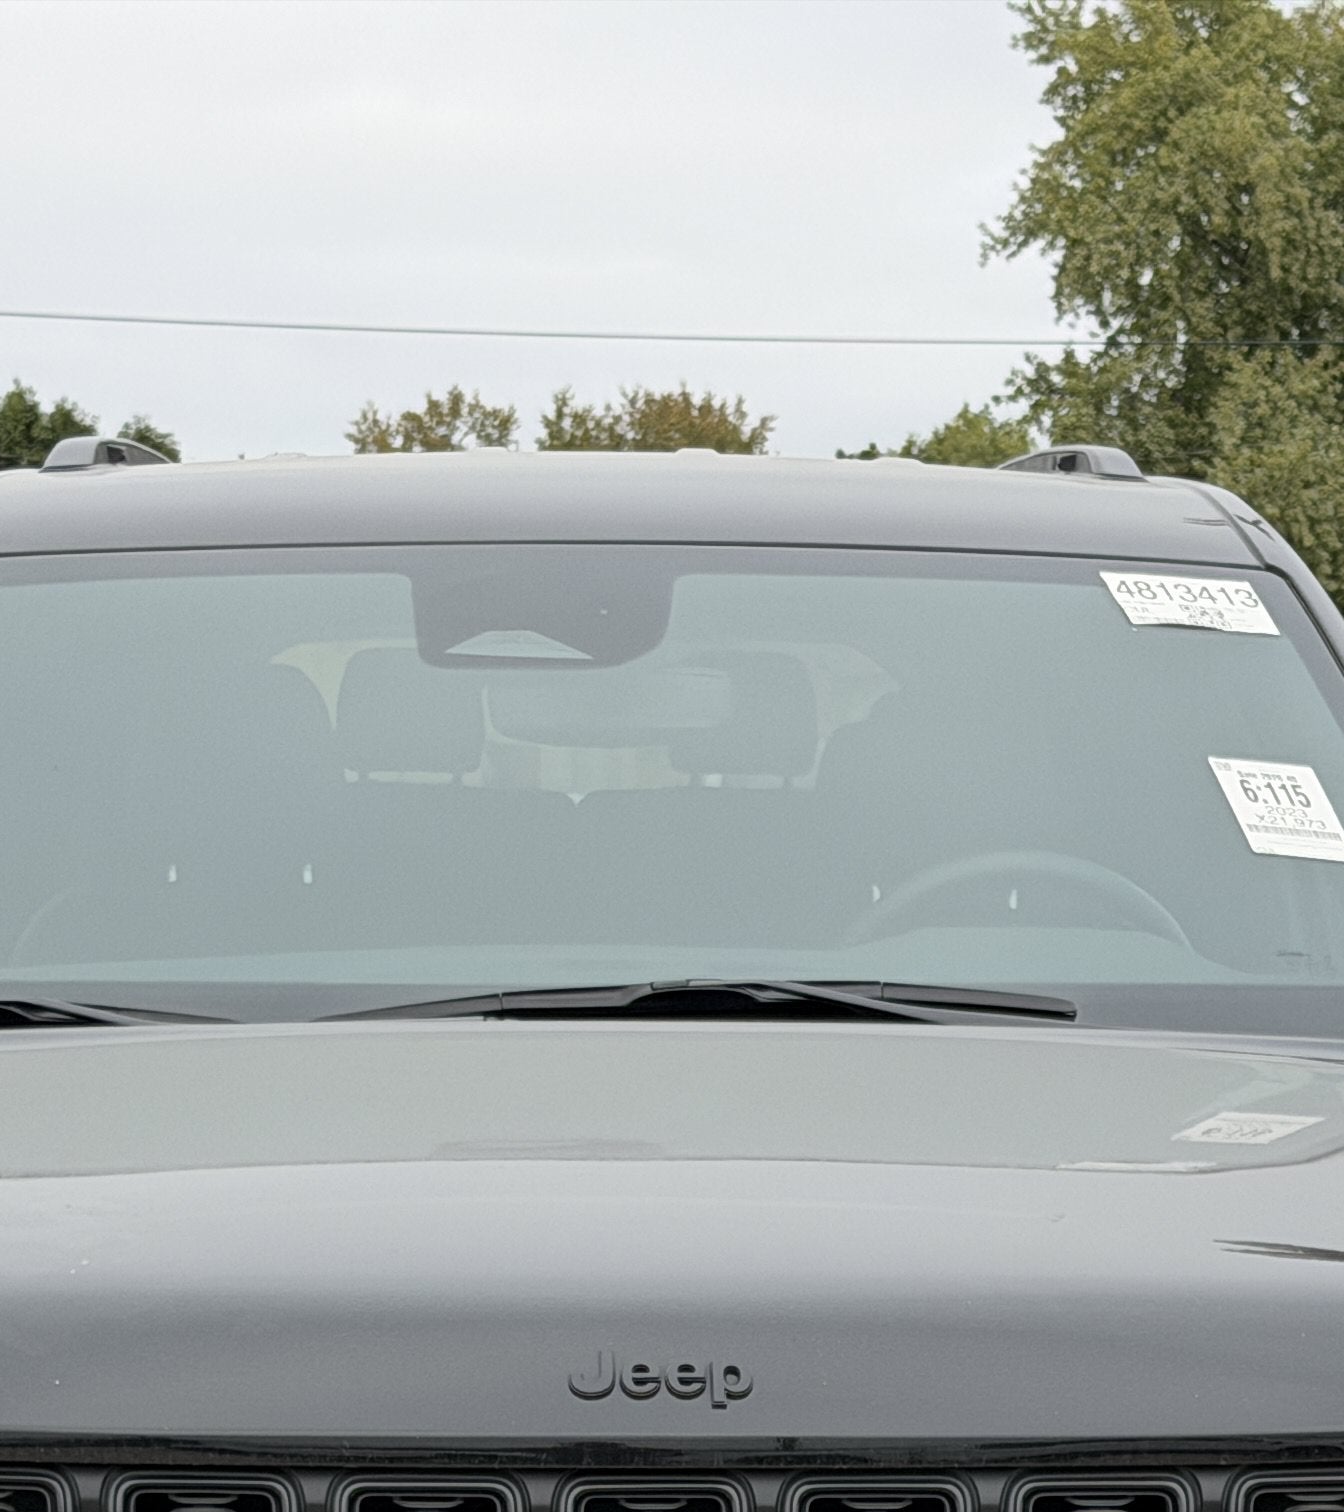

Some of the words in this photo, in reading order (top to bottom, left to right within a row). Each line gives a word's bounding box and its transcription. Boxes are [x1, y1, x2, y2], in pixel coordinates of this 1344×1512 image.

[1116, 580, 1259, 608] 4813413
[1239, 779, 1312, 809] 6:115
[1264, 805, 1309, 819] 2023
[567, 1349, 754, 1410] Jeep
